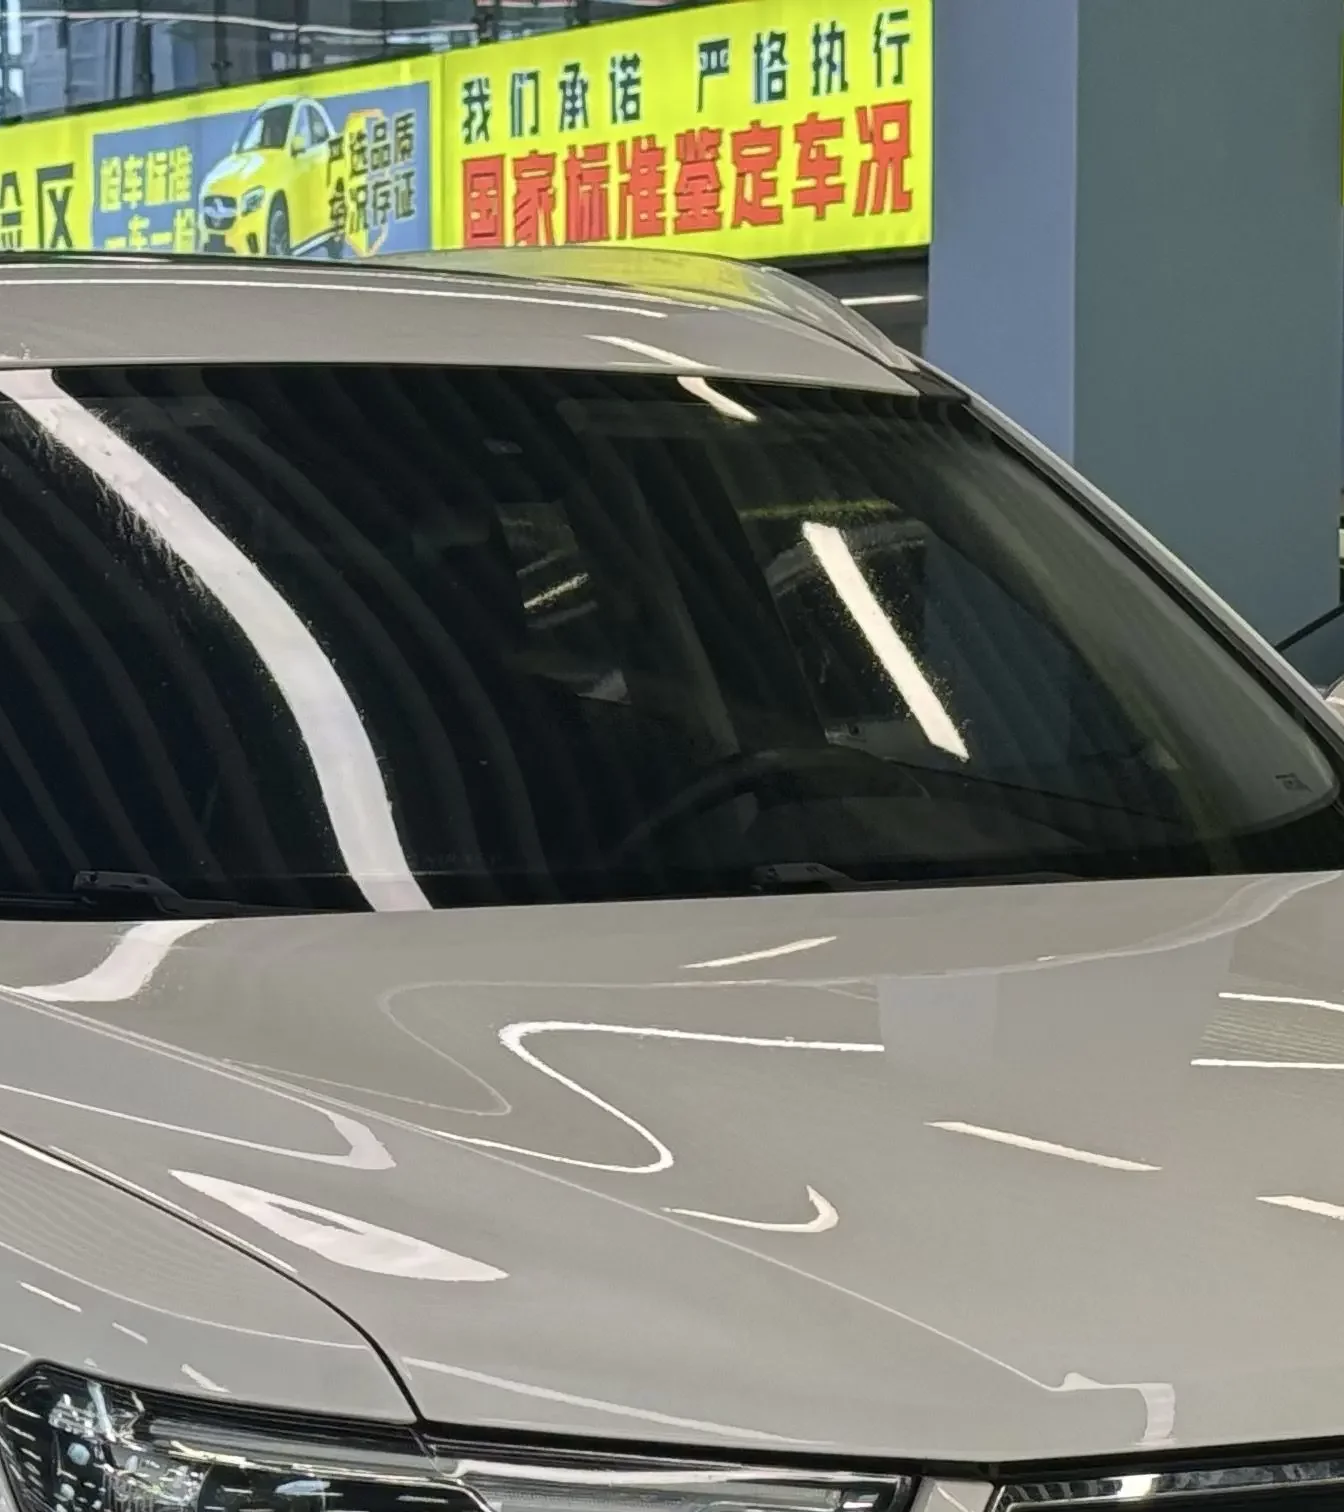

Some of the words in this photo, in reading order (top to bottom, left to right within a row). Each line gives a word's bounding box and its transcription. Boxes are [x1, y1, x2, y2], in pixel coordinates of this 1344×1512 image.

[461, 52, 642, 145] 我们承诺
[696, 8, 912, 113] 严格执行
[461, 100, 914, 249] 国家标准鉴定车况
